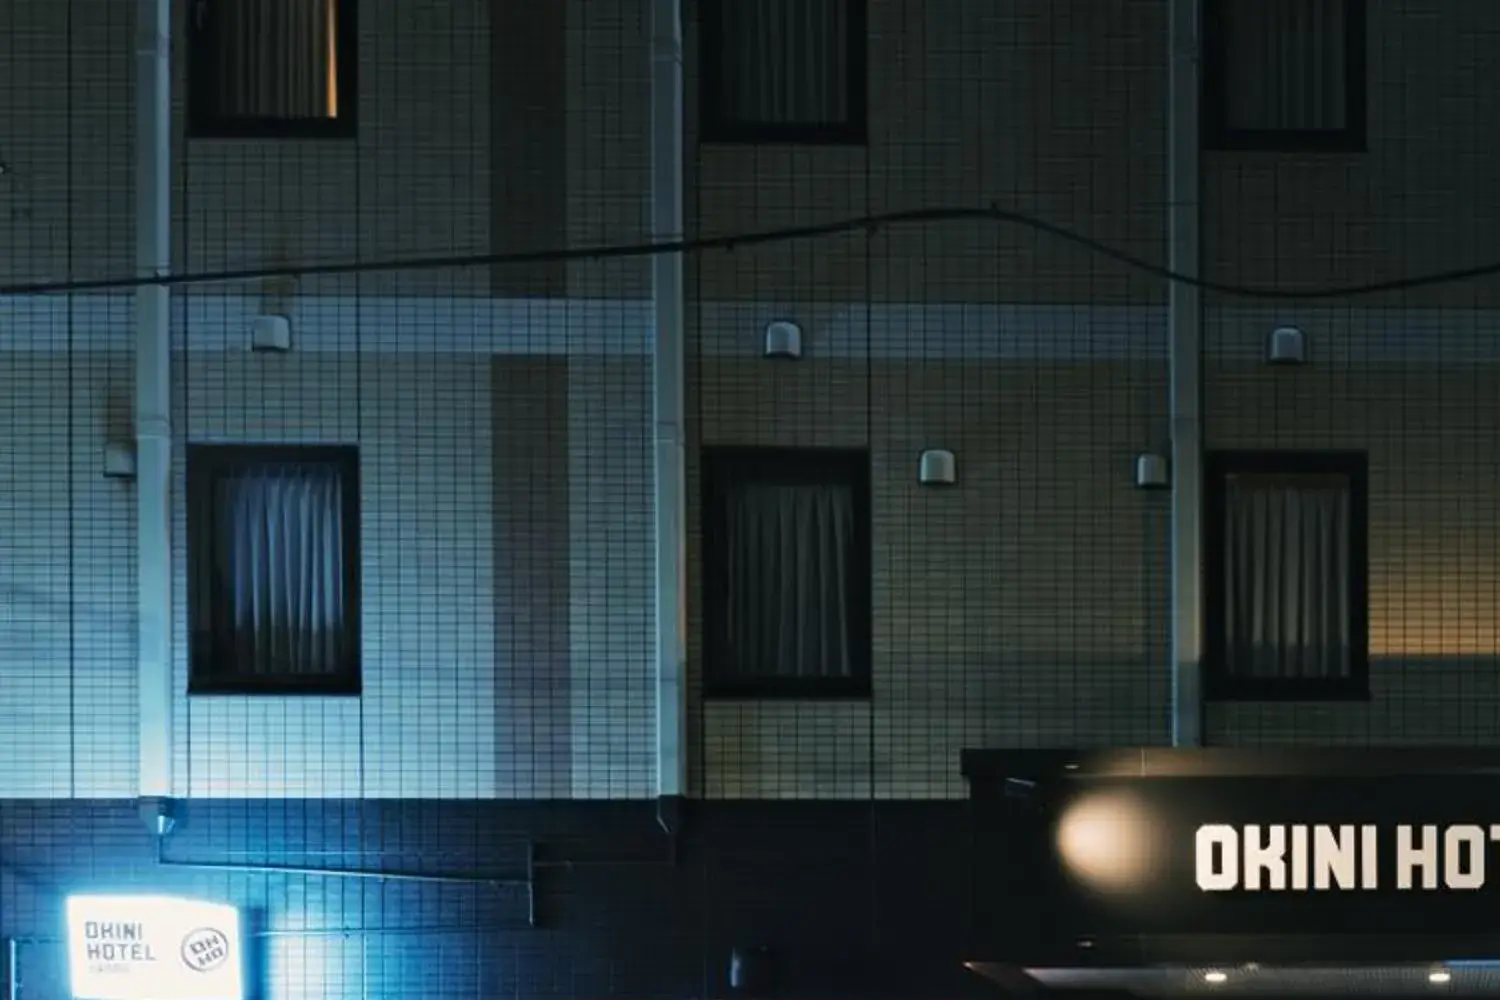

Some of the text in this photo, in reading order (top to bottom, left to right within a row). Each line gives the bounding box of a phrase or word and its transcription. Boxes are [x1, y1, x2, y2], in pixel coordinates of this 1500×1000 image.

[1195, 824, 1377, 891] OKINI
[85, 921, 143, 940] OKINI
[87, 943, 157, 961] HOTEL
